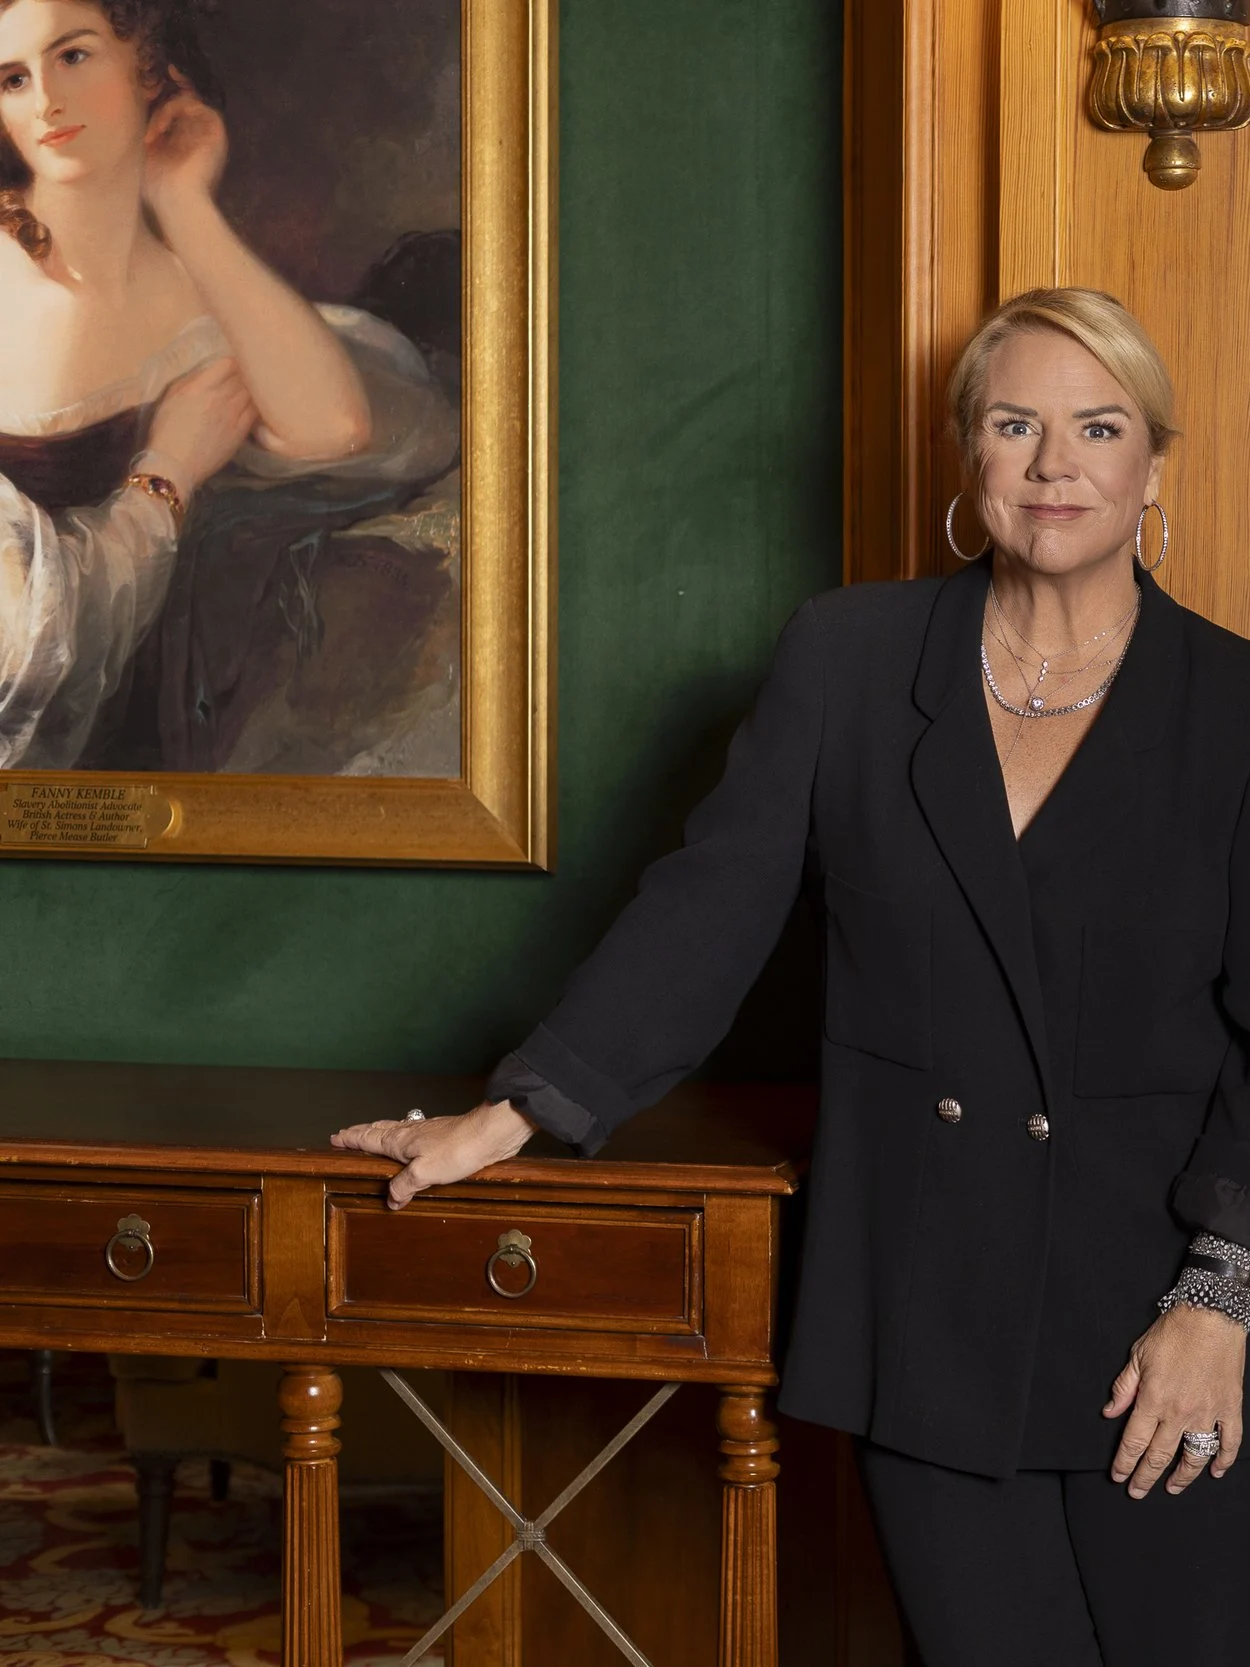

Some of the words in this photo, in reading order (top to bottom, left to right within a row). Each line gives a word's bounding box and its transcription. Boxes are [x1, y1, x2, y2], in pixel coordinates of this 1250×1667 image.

[31, 787, 73, 800] FANNY
[76, 788, 126, 801] KEMBLE
[12, 799, 46, 811] Slavery
[49, 800, 99, 810] Abolitionist
[23, 809, 52, 819] British
[53, 810, 86, 820] Actress
[88, 811, 96, 820] &
[98, 811, 130, 821] Author
[8, 819, 28, 830] Wife
[30, 820, 40, 830] of
[41, 821, 52, 830] St.
[56, 821, 88, 831] Simons
[30, 831, 56, 841] Pierce
[59, 832, 88, 841] Mease
[91, 832, 118, 842] Butler
